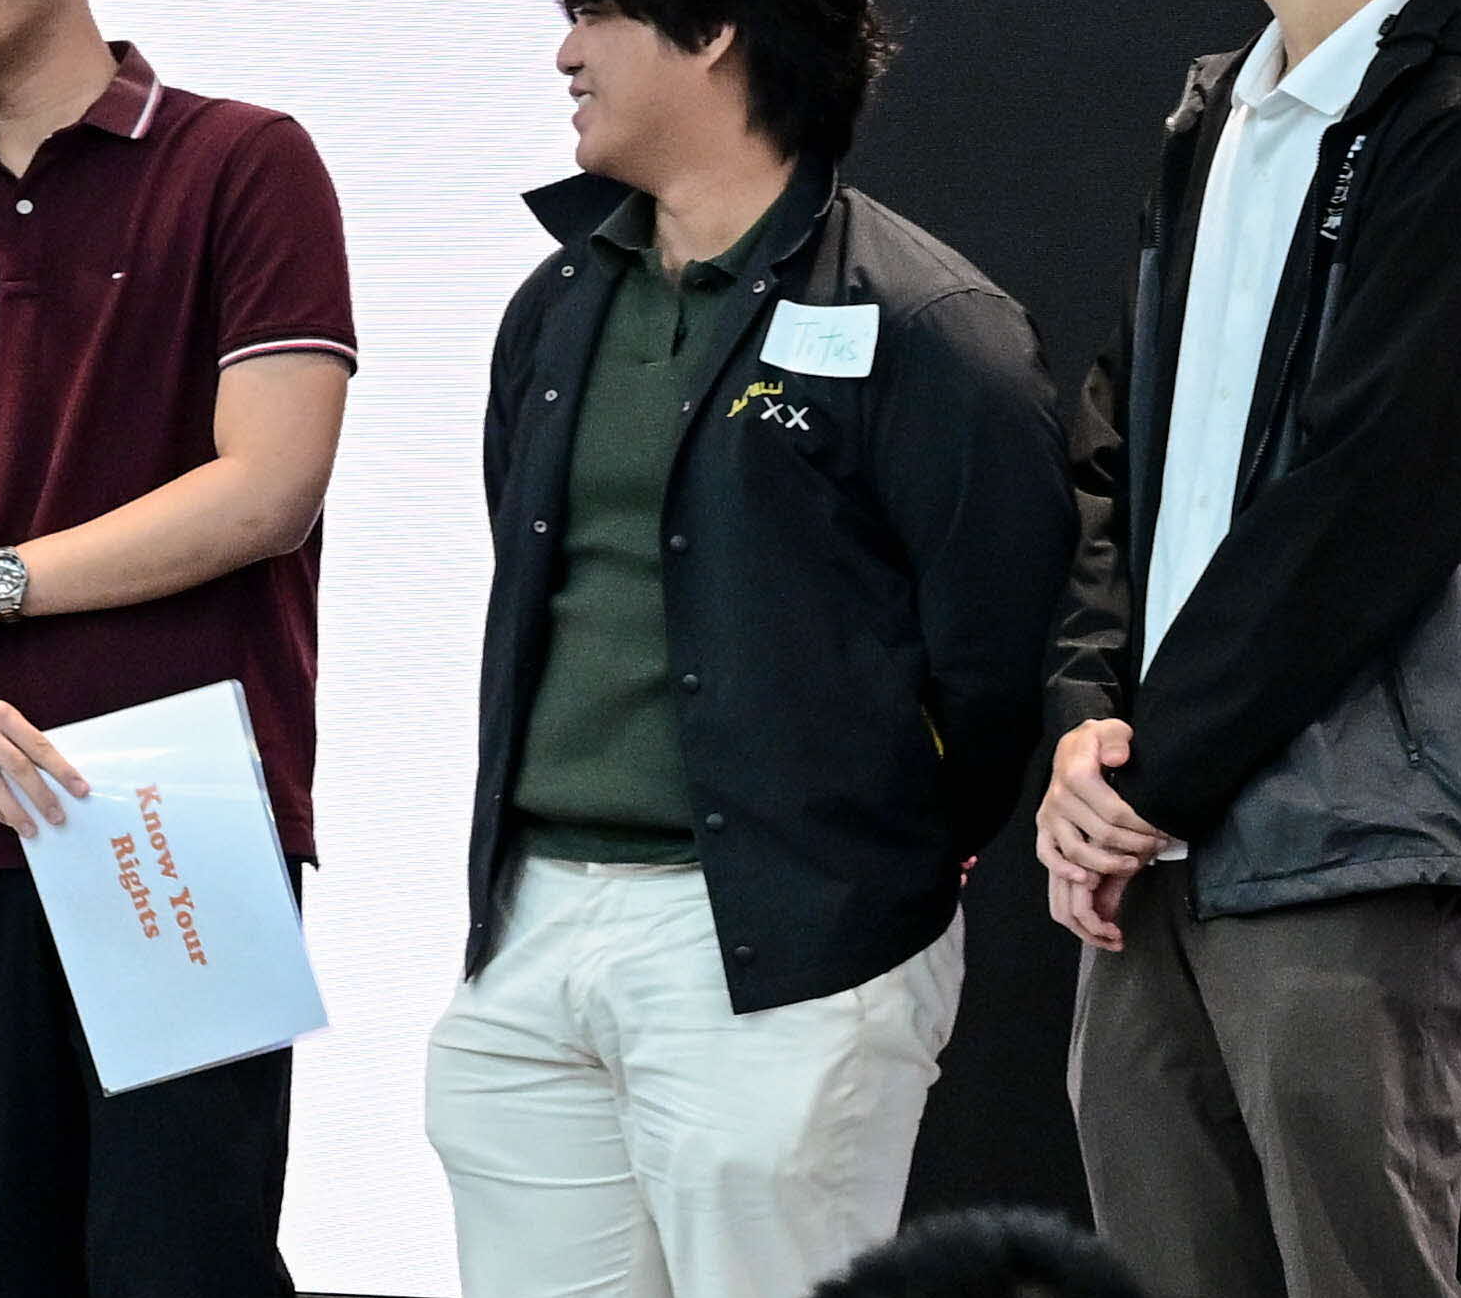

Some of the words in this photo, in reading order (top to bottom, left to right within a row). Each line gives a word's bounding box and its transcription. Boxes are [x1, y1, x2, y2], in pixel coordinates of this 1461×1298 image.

[110, 832, 160, 941] Rights
[136, 782, 178, 880] Know
[168, 885, 209, 966] Your
